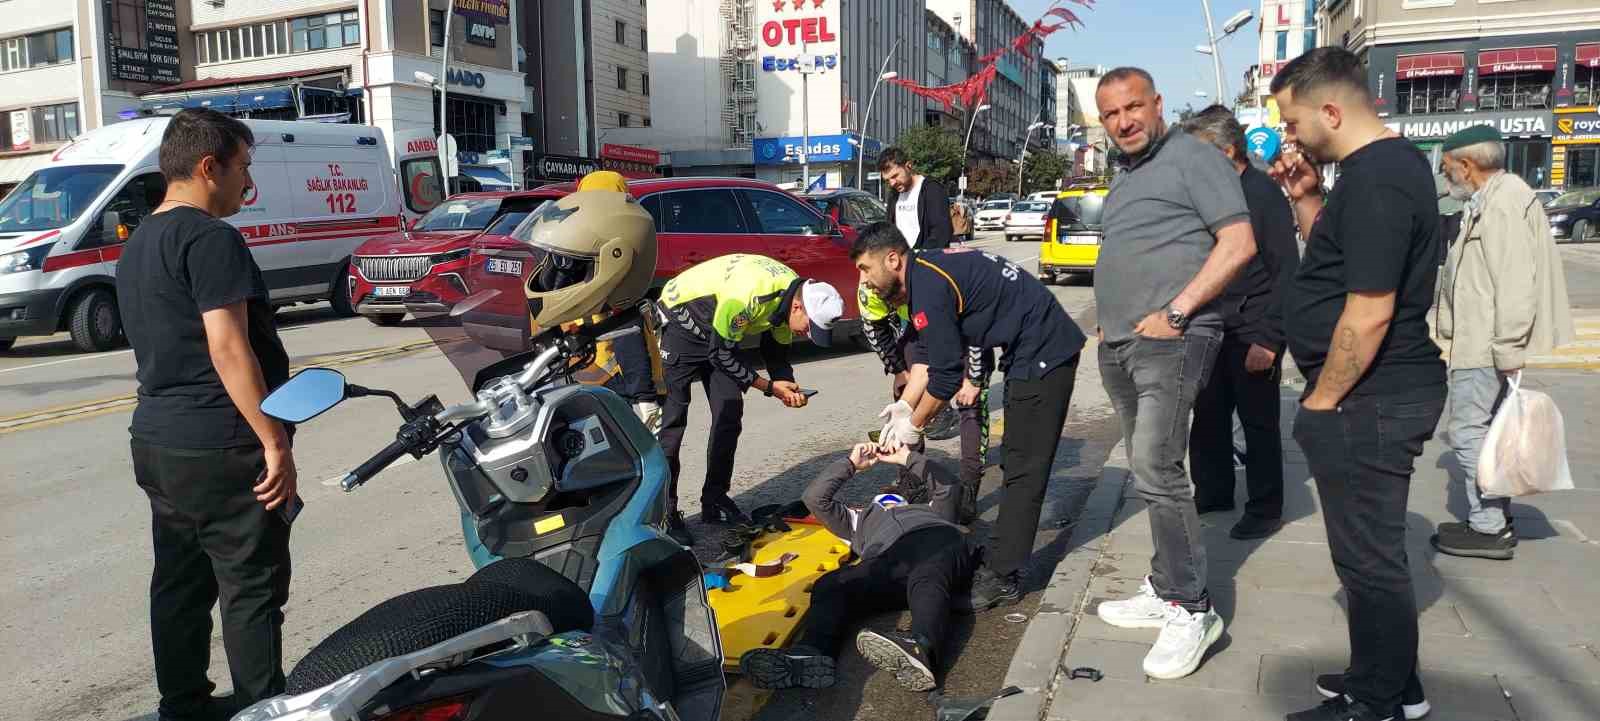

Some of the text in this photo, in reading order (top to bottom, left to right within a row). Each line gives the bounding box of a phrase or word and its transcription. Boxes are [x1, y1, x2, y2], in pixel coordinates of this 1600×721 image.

[762, 16, 836, 47] OTEL
[1500, 117, 1546, 133] USTA
[328, 163, 344, 177] T.C.
[306, 176, 369, 192] SAĞLIK BAKANLIĞI
[326, 192, 357, 214] 112
